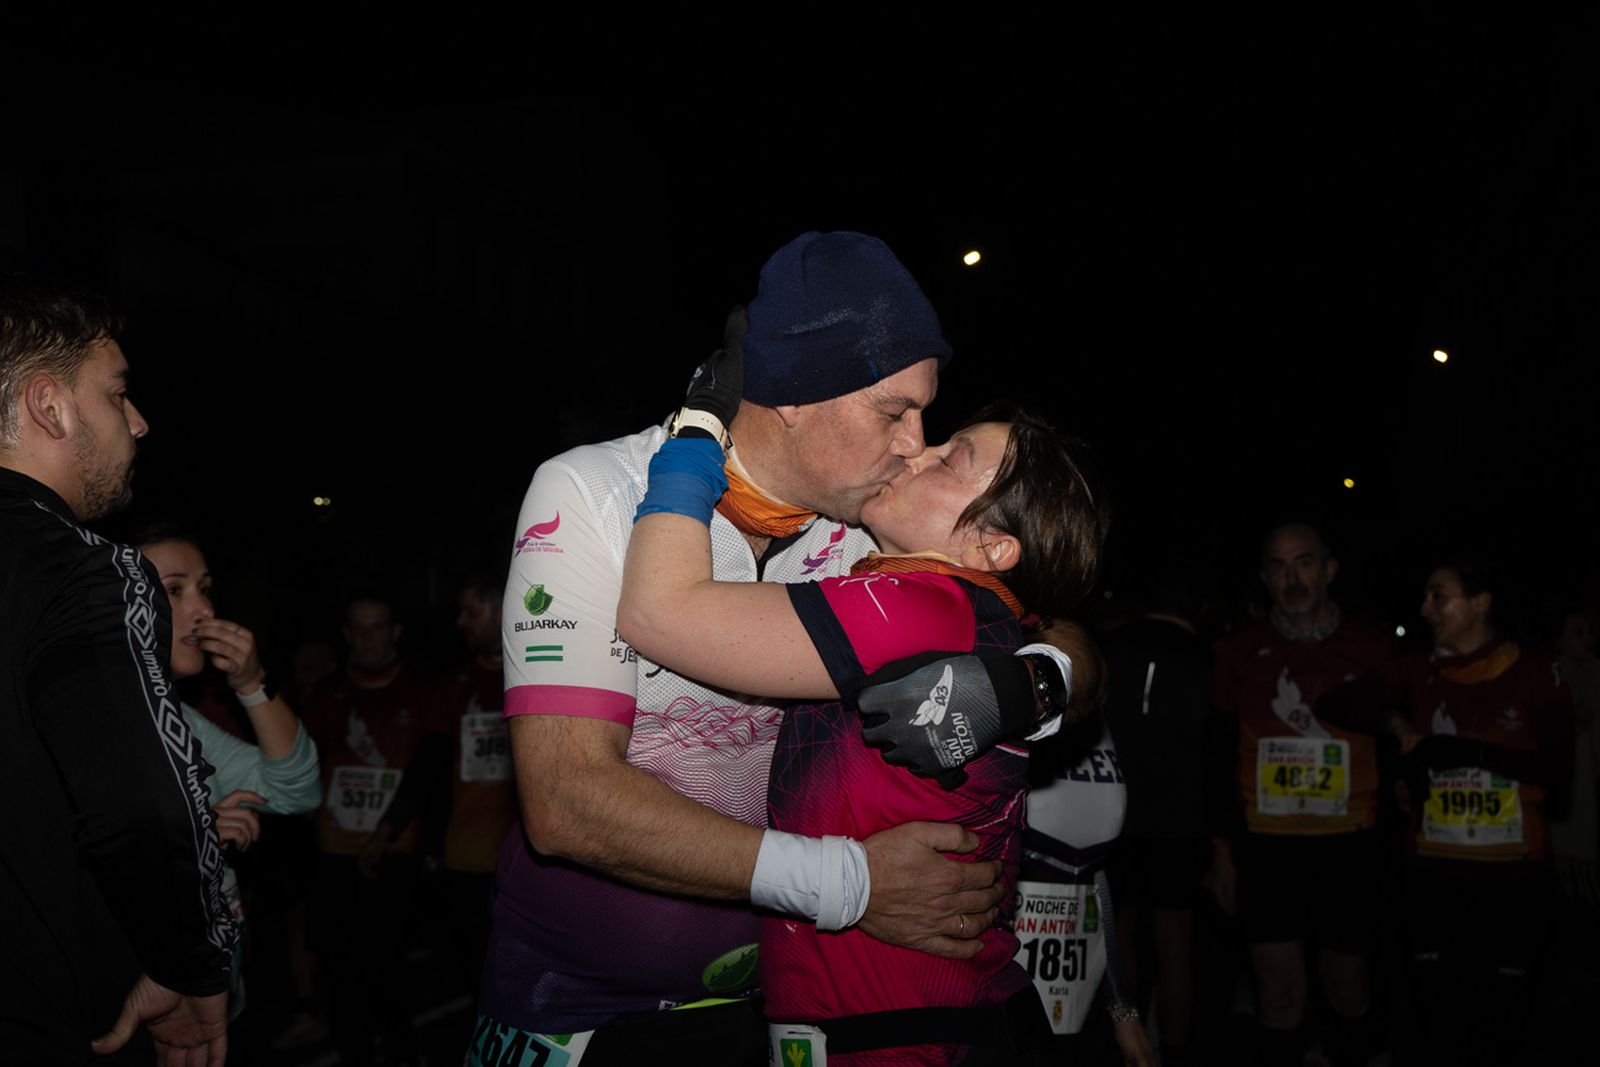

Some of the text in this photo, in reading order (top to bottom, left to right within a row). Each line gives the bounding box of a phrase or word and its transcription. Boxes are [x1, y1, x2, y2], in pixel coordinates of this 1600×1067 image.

[121, 547, 147, 595] umbro
[515, 619, 577, 632] BUJARKAY
[141, 649, 168, 697] umbro
[935, 685, 949, 707] 43
[950, 712, 976, 760] NTÓN
[186, 764, 211, 828] umbro
[1439, 790, 1501, 816] 1905
[1025, 900, 1080, 915] NOCHE DE
[1015, 917, 1038, 933] AN
[1048, 986, 1070, 996] Karla
